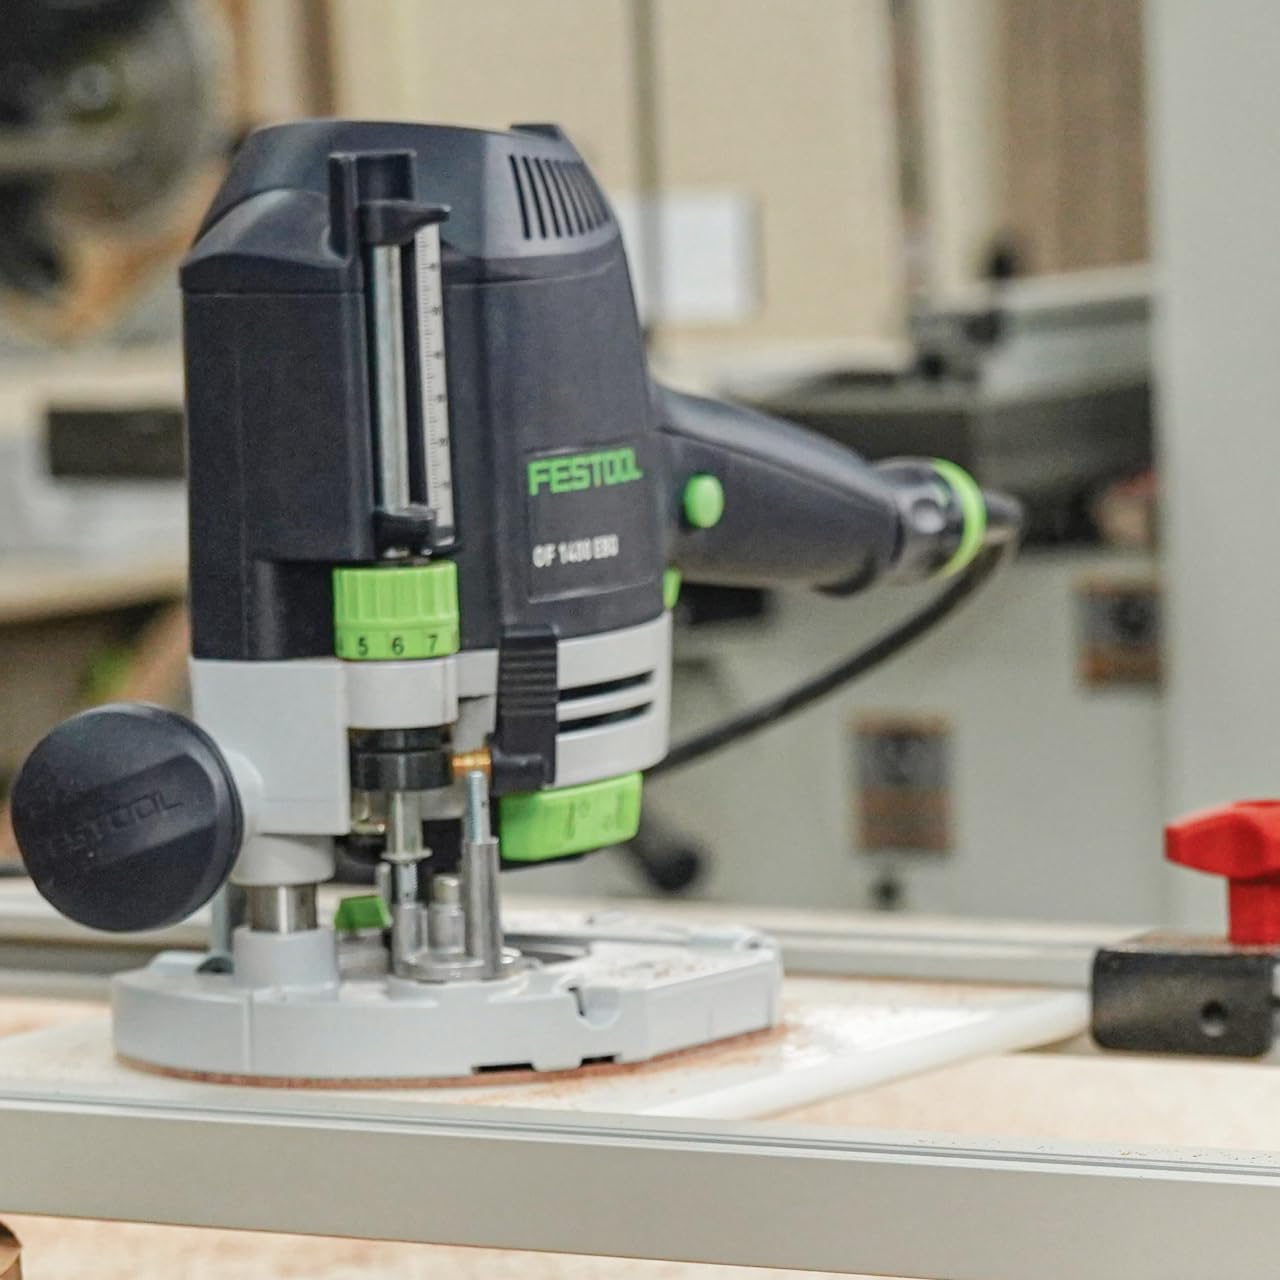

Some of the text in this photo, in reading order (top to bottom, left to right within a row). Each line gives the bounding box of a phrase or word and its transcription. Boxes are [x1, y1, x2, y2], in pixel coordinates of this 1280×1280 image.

[528, 447, 643, 496] FESTOOL
[357, 636, 369, 656] 5
[391, 636, 405, 656] 6
[427, 634, 438, 654] 7
[36, 788, 185, 864] STOOL
